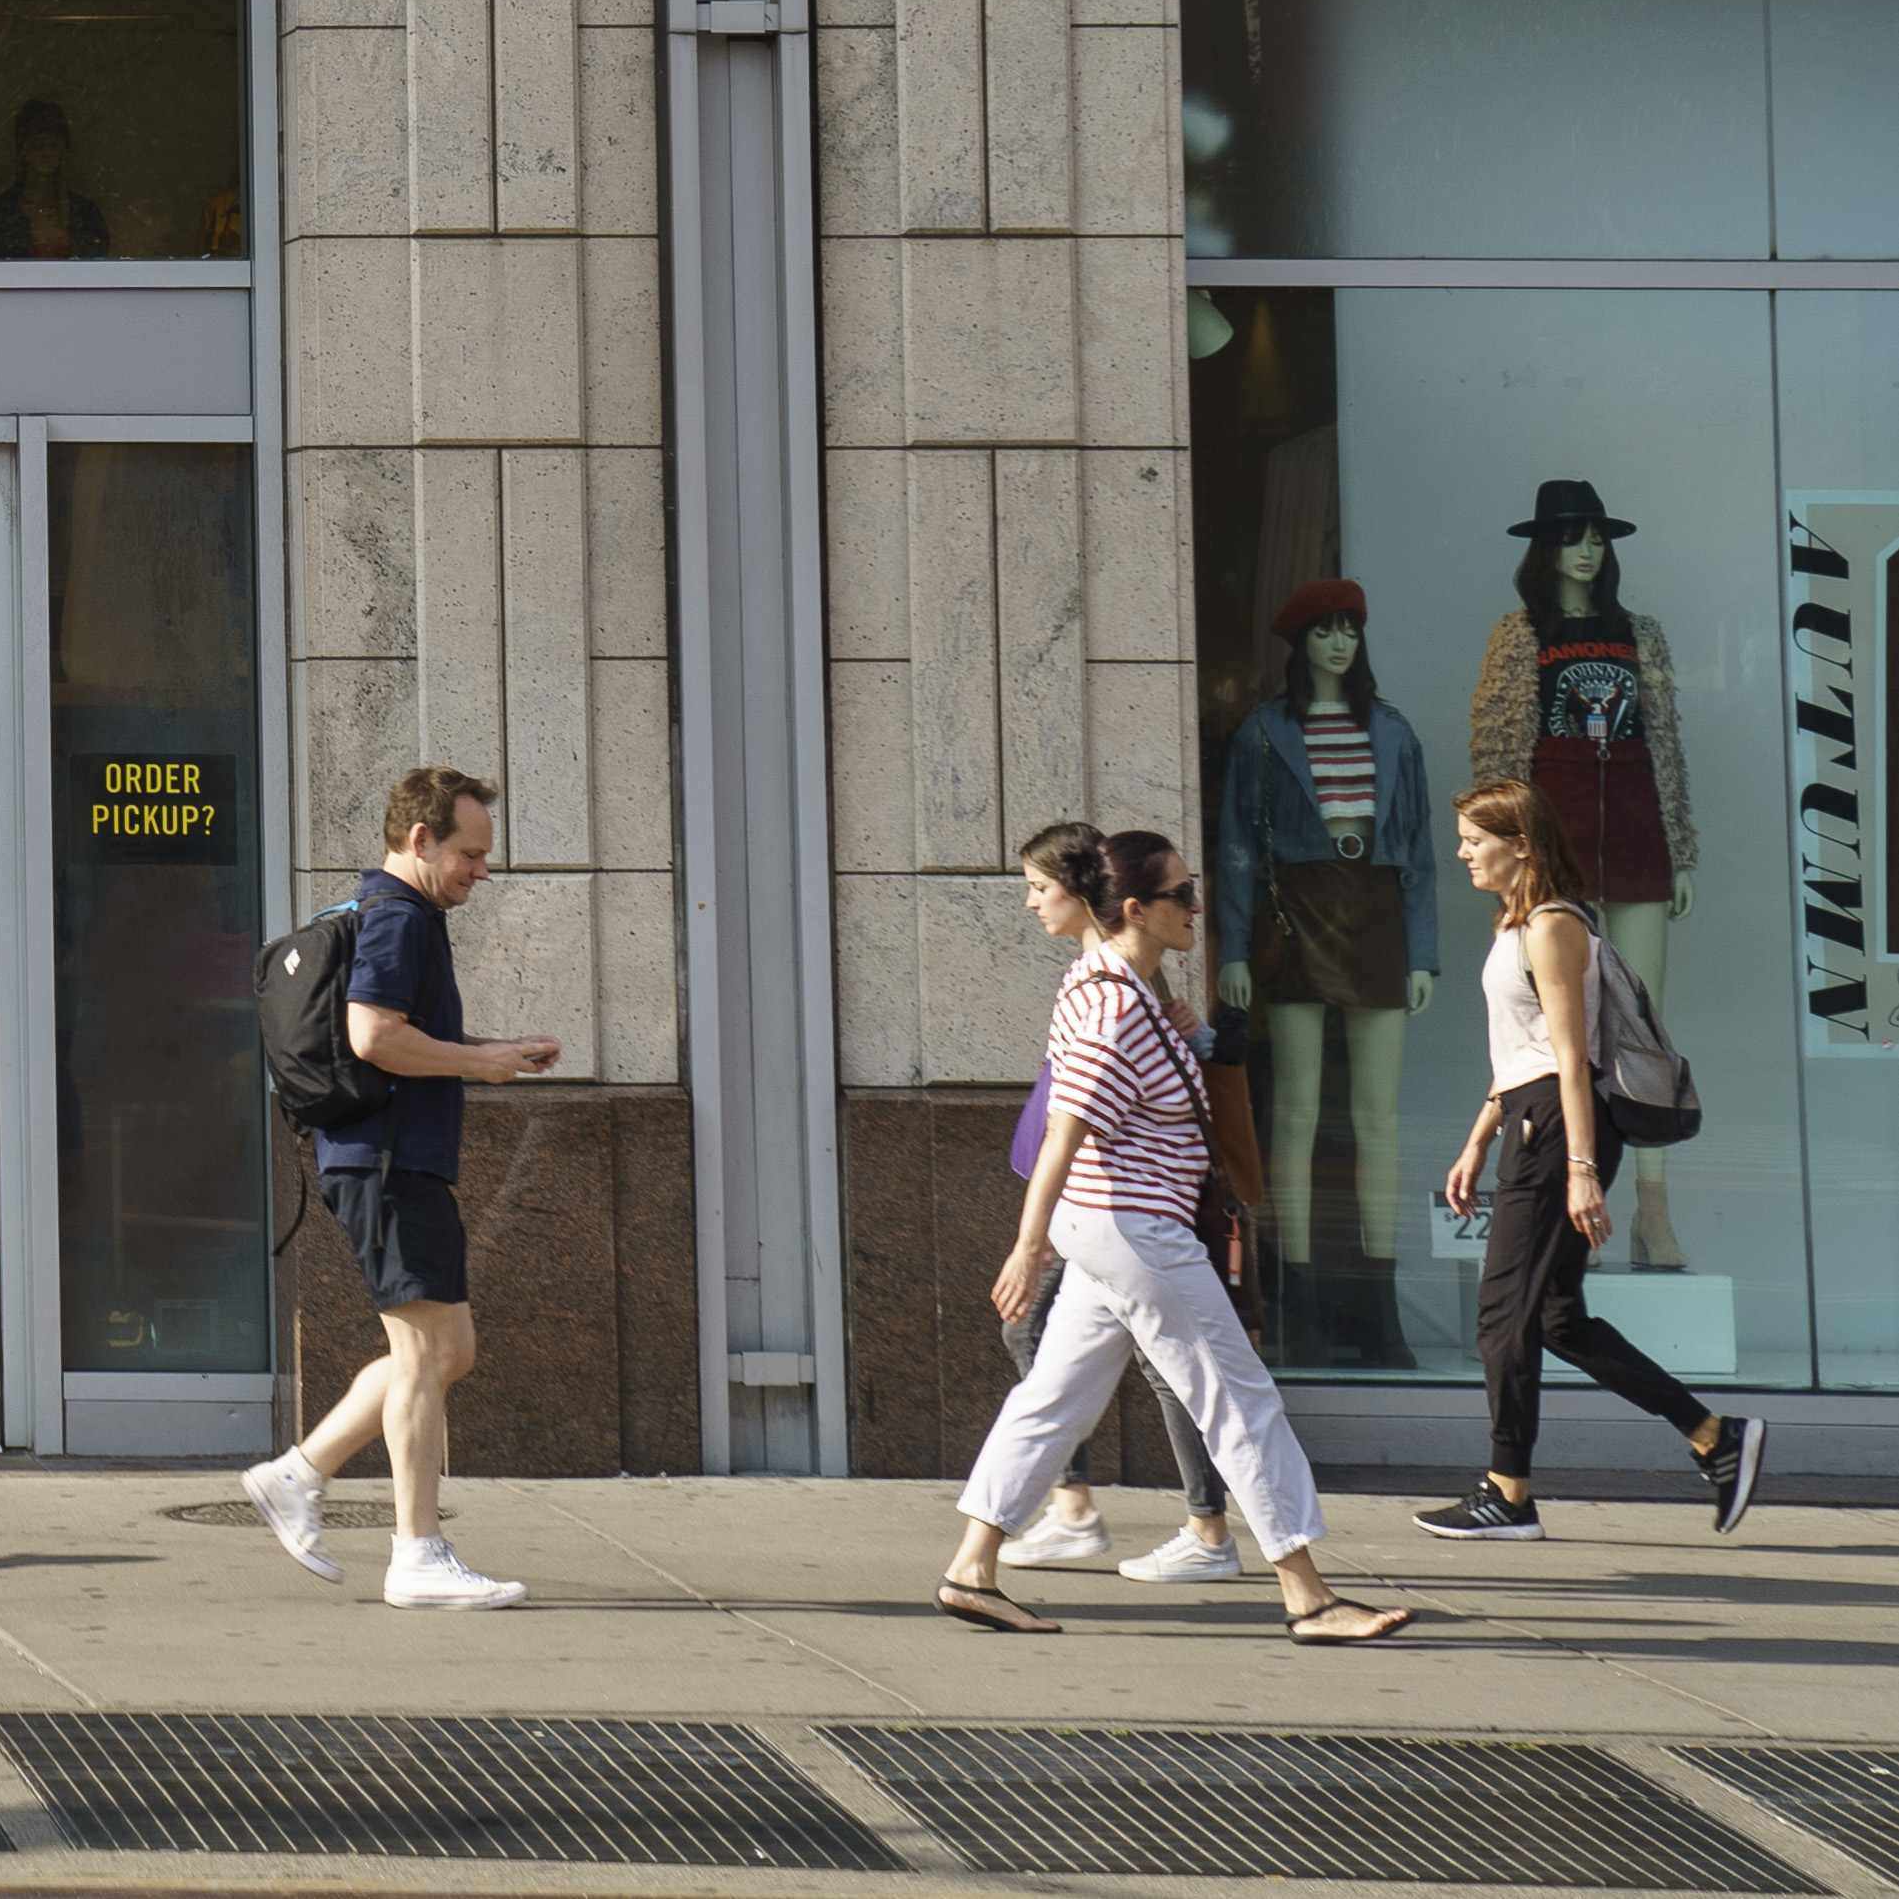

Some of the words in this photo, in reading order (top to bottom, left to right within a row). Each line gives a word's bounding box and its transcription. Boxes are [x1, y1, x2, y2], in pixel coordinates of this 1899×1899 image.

[105, 763, 200, 794] ORDER
[1788, 509, 1870, 1041] AUTUMN
[92, 804, 215, 836] PICKUP?
